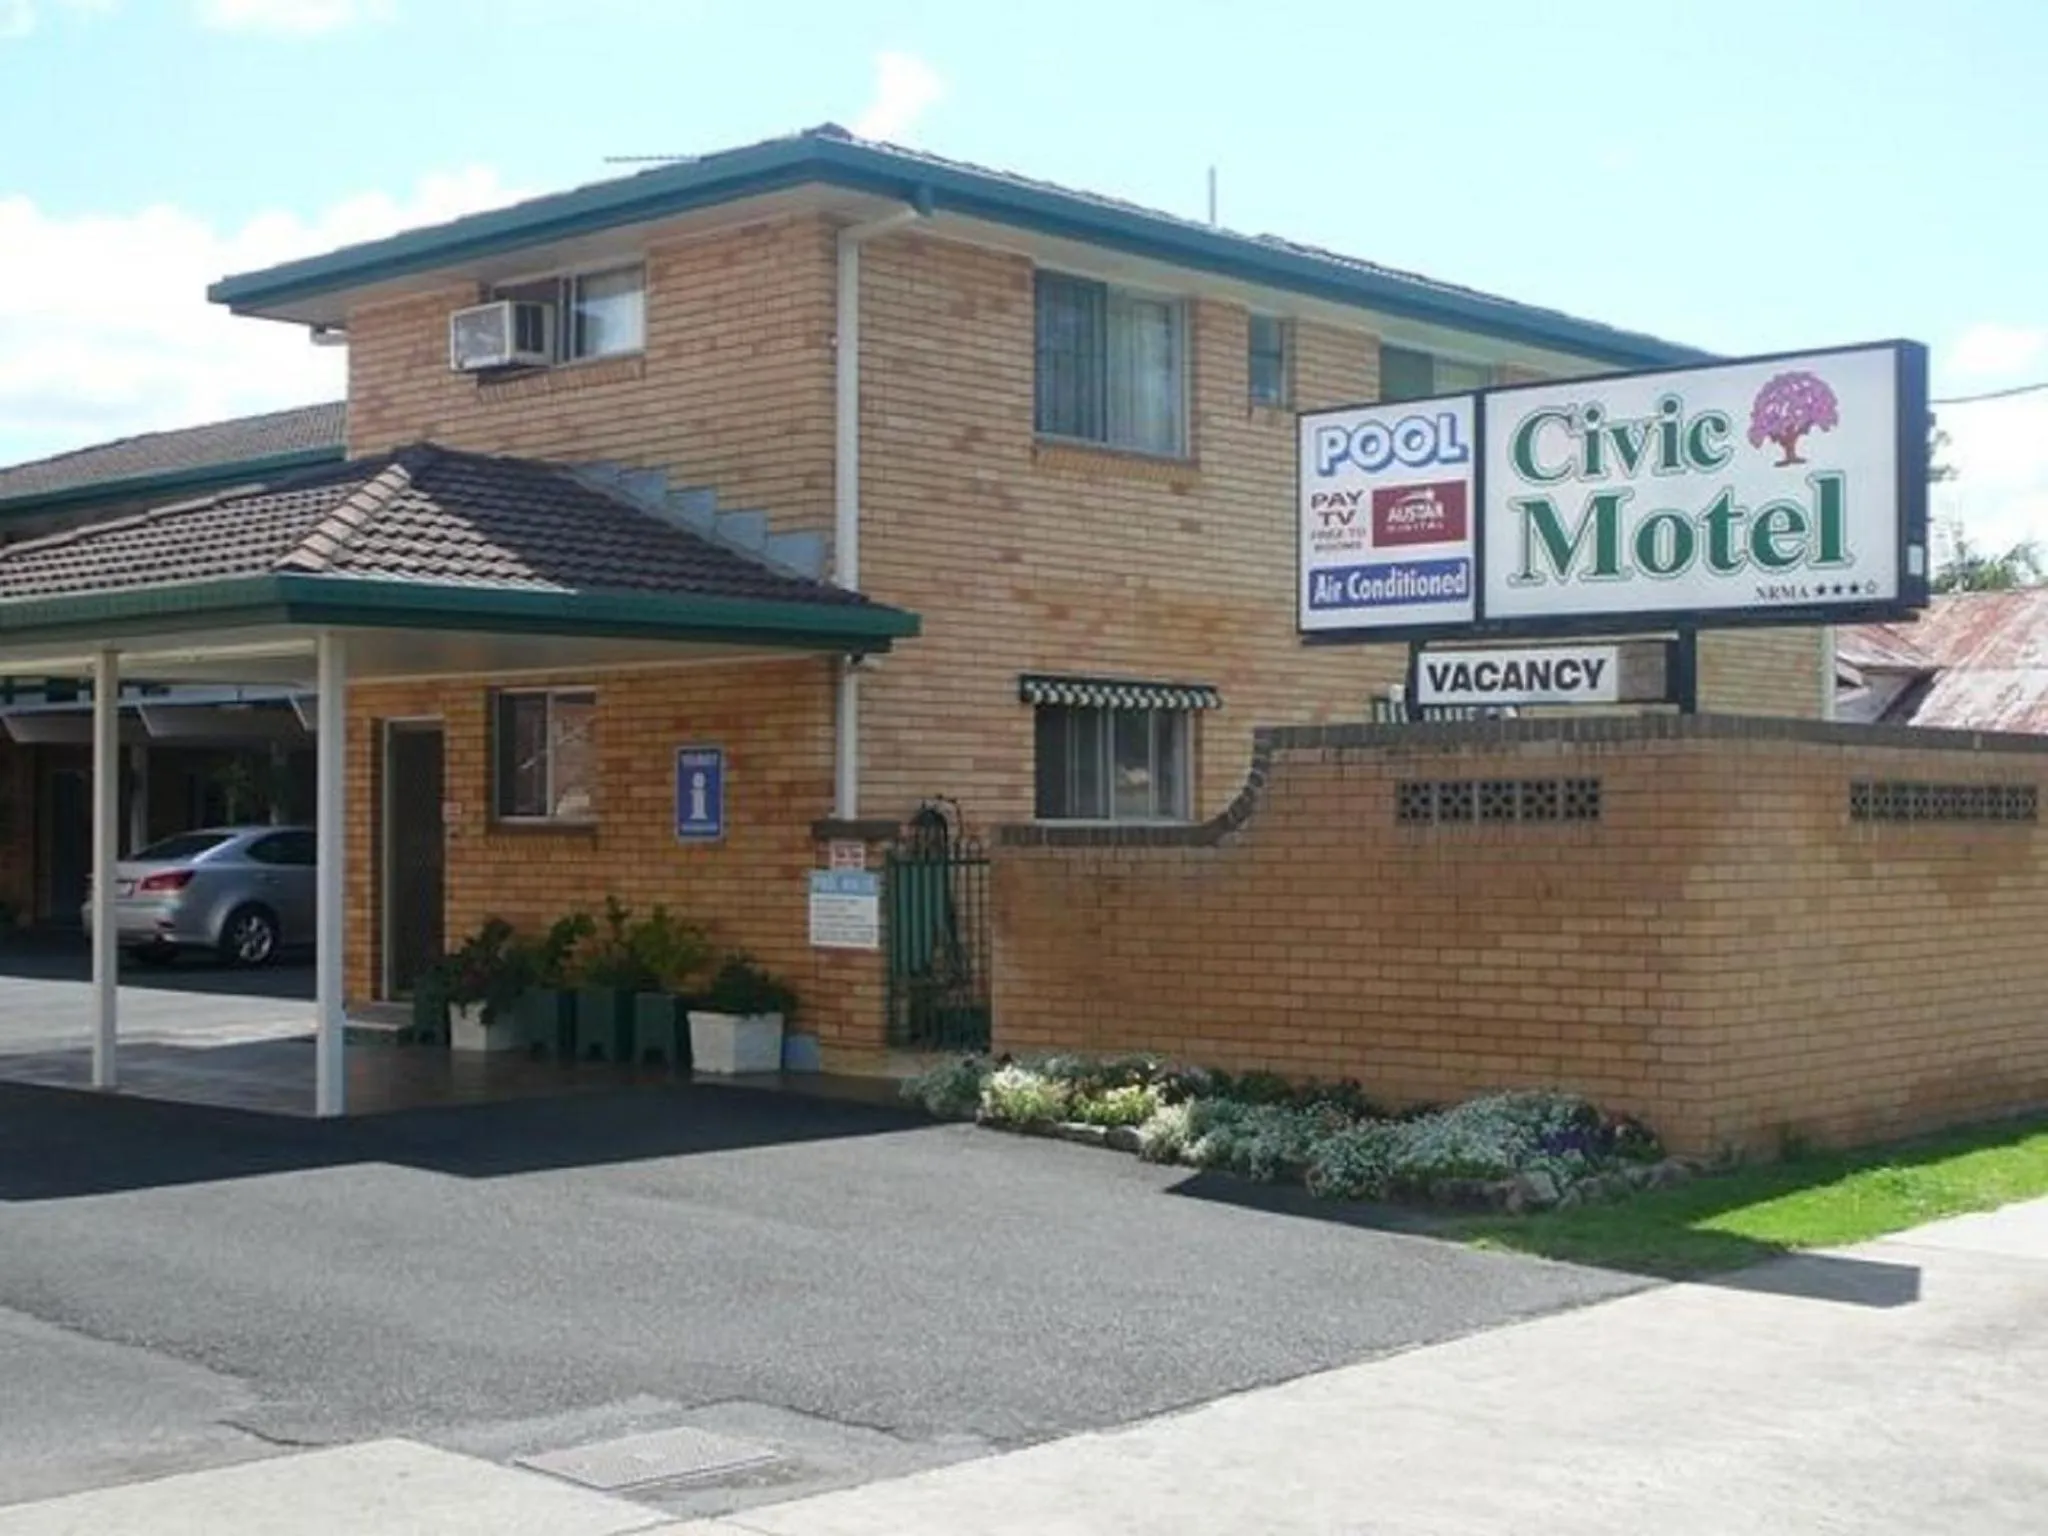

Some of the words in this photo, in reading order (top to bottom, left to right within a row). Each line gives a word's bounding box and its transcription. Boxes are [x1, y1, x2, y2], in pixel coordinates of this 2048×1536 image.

[1315, 412, 1468, 477] POOL
[1508, 393, 1732, 486] Civic
[1311, 488, 1365, 509] PAY
[1318, 509, 1357, 527] TV
[1506, 470, 1855, 587] Motel
[1314, 573, 1343, 604] Air
[1348, 561, 1468, 600] Conditioned
[1756, 583, 1811, 600] NRMA
[1427, 658, 1606, 693] VACANCY
